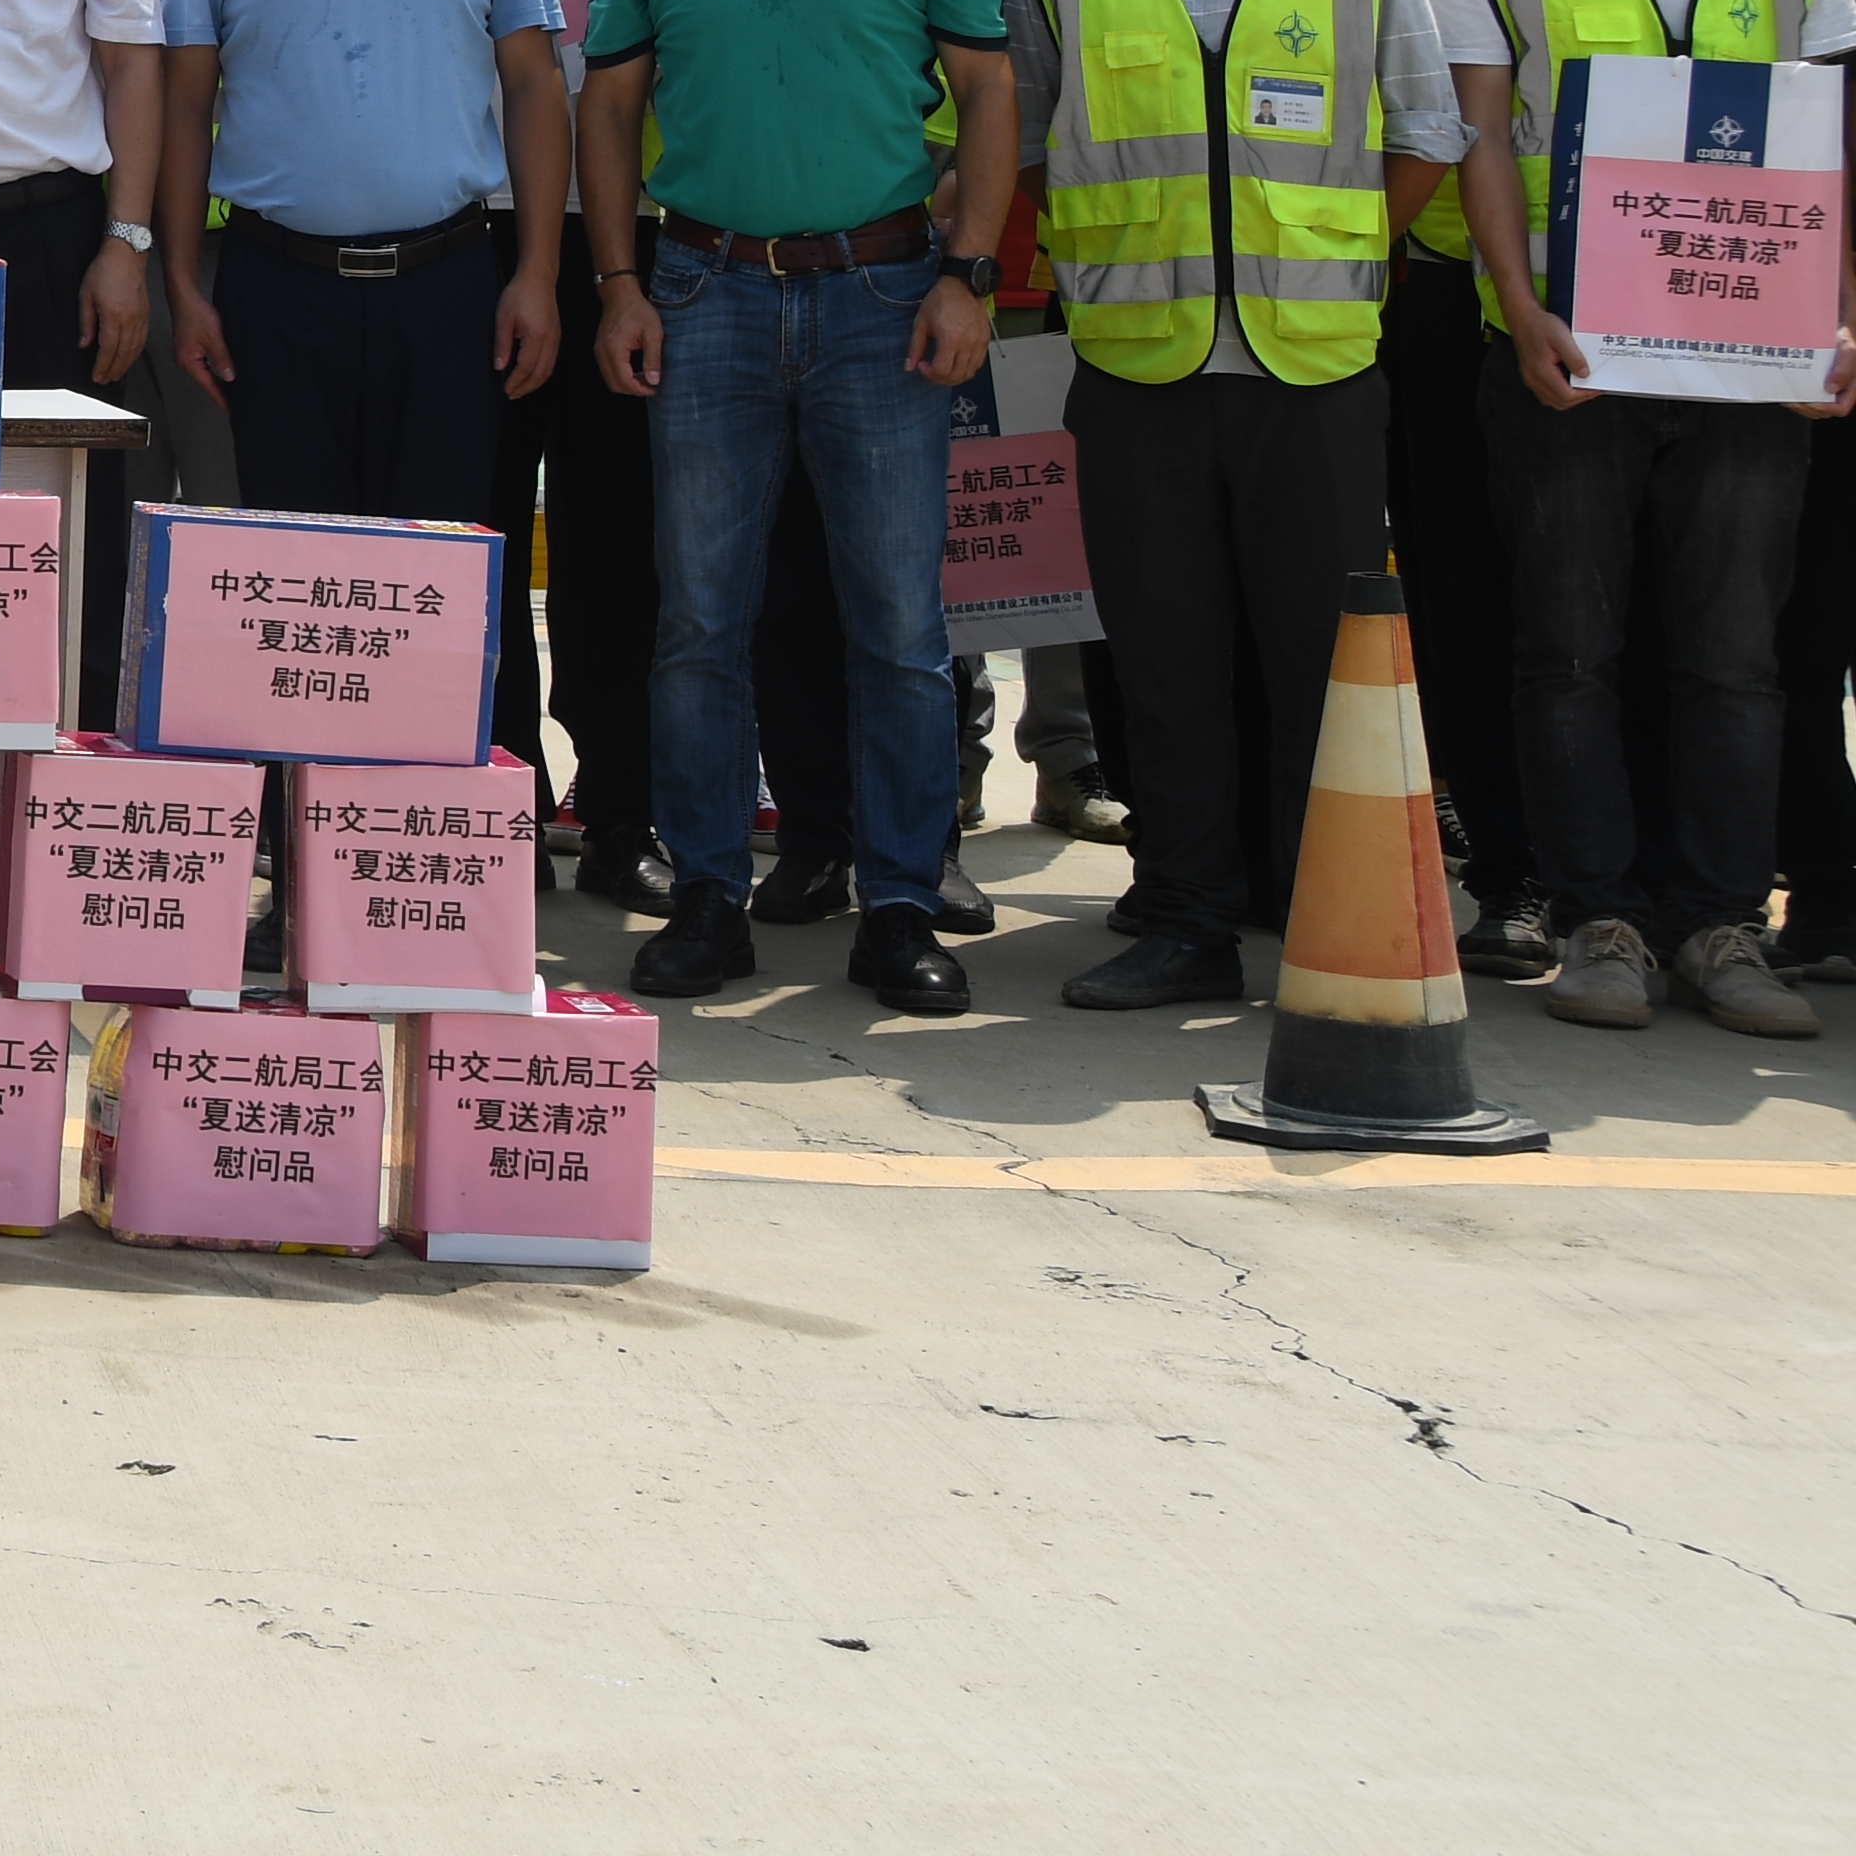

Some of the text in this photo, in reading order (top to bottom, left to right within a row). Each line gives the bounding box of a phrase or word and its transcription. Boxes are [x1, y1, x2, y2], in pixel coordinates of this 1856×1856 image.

[1696, 148, 1753, 162] 中国交建
[1613, 190, 1826, 231] 中交二航局工会
[1641, 229, 1798, 265] “夏送清凉”
[1667, 269, 1760, 300] 慰问品
[948, 496, 1043, 530] 送清凉”
[210, 568, 446, 617] 中交二航局工会
[240, 617, 410, 659] “夏送清凉”
[270, 666, 370, 703] 慰问品
[25, 795, 256, 841] 中交二航局工会
[304, 800, 536, 842] 中交二航局工会
[49, 843, 225, 885] “夏送清凉”
[334, 848, 504, 887] “夏送清凉”
[80, 892, 185, 930] 慰问品
[365, 896, 466, 932] 慰问品
[152, 1046, 384, 1093] 中交二航局工会
[428, 1049, 657, 1092] 中交二航局工会
[182, 1095, 355, 1138] “夏送清凉”
[457, 1097, 626, 1137] “夏送清凉”
[212, 1145, 315, 1184] 慰问品
[488, 1146, 589, 1183] 慰问品
